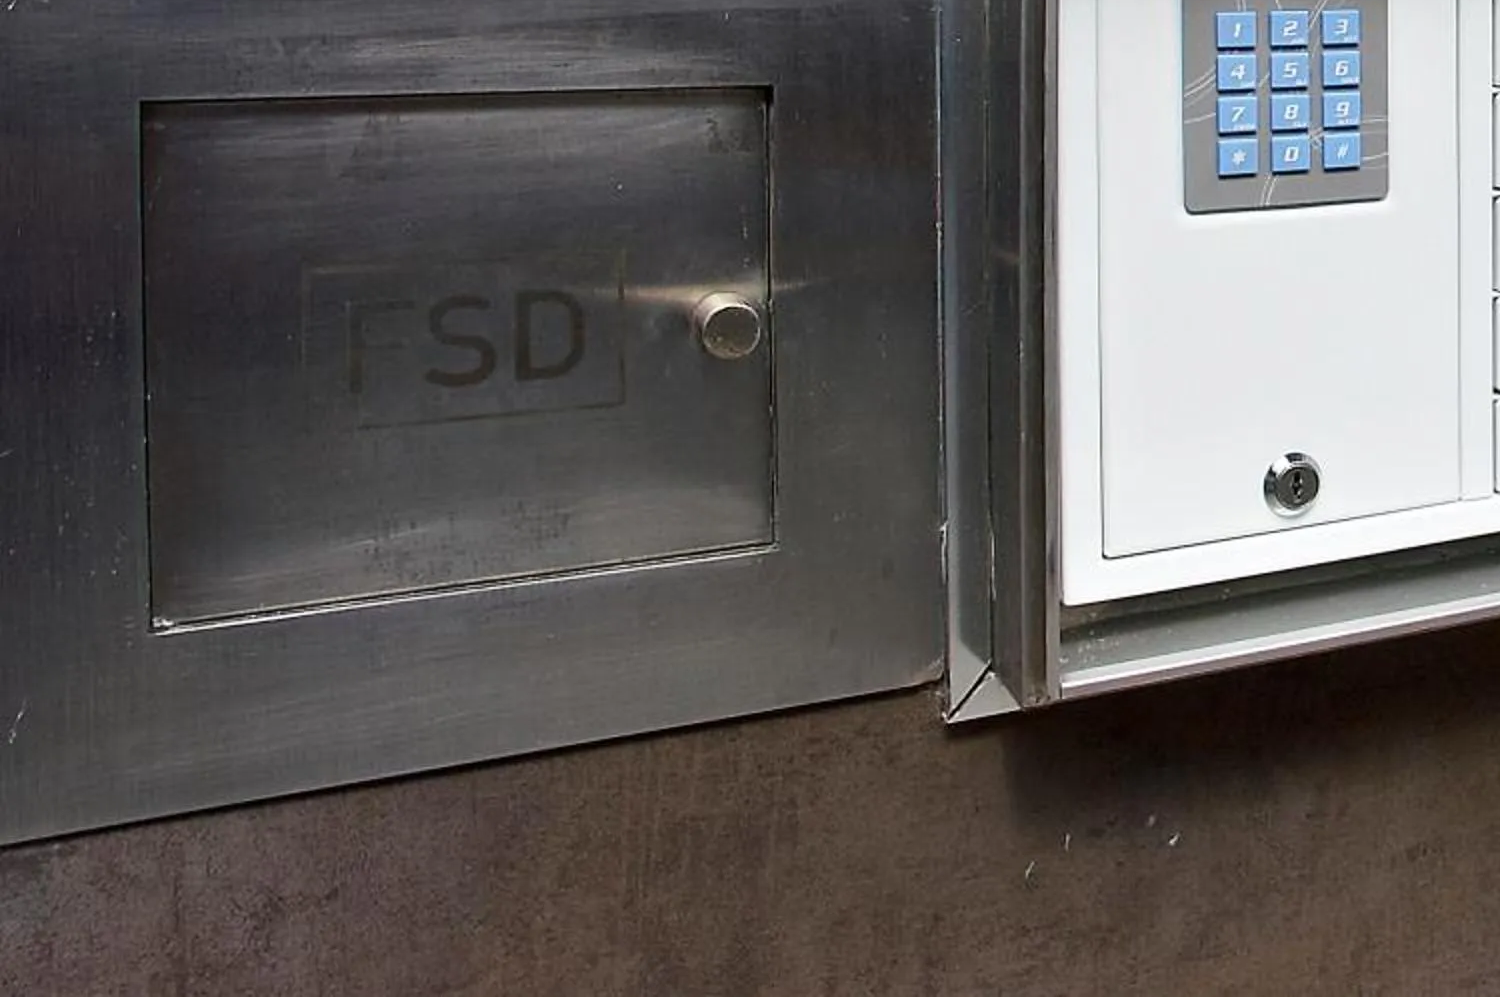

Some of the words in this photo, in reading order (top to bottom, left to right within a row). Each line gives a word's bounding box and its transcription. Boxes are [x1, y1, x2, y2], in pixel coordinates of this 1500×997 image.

[1232, 23, 1242, 37] 1
[1283, 20, 1298, 36] 2
[1334, 18, 1349, 34] 3
[1231, 64, 1245, 80] 4
[1282, 62, 1299, 78] 5
[1335, 60, 1349, 76] 6
[1231, 106, 1246, 122] 7
[1284, 104, 1299, 120] 8
[1335, 101, 1350, 118] 9
[1283, 146, 1299, 162] 0
[350, 288, 586, 394] FSD
